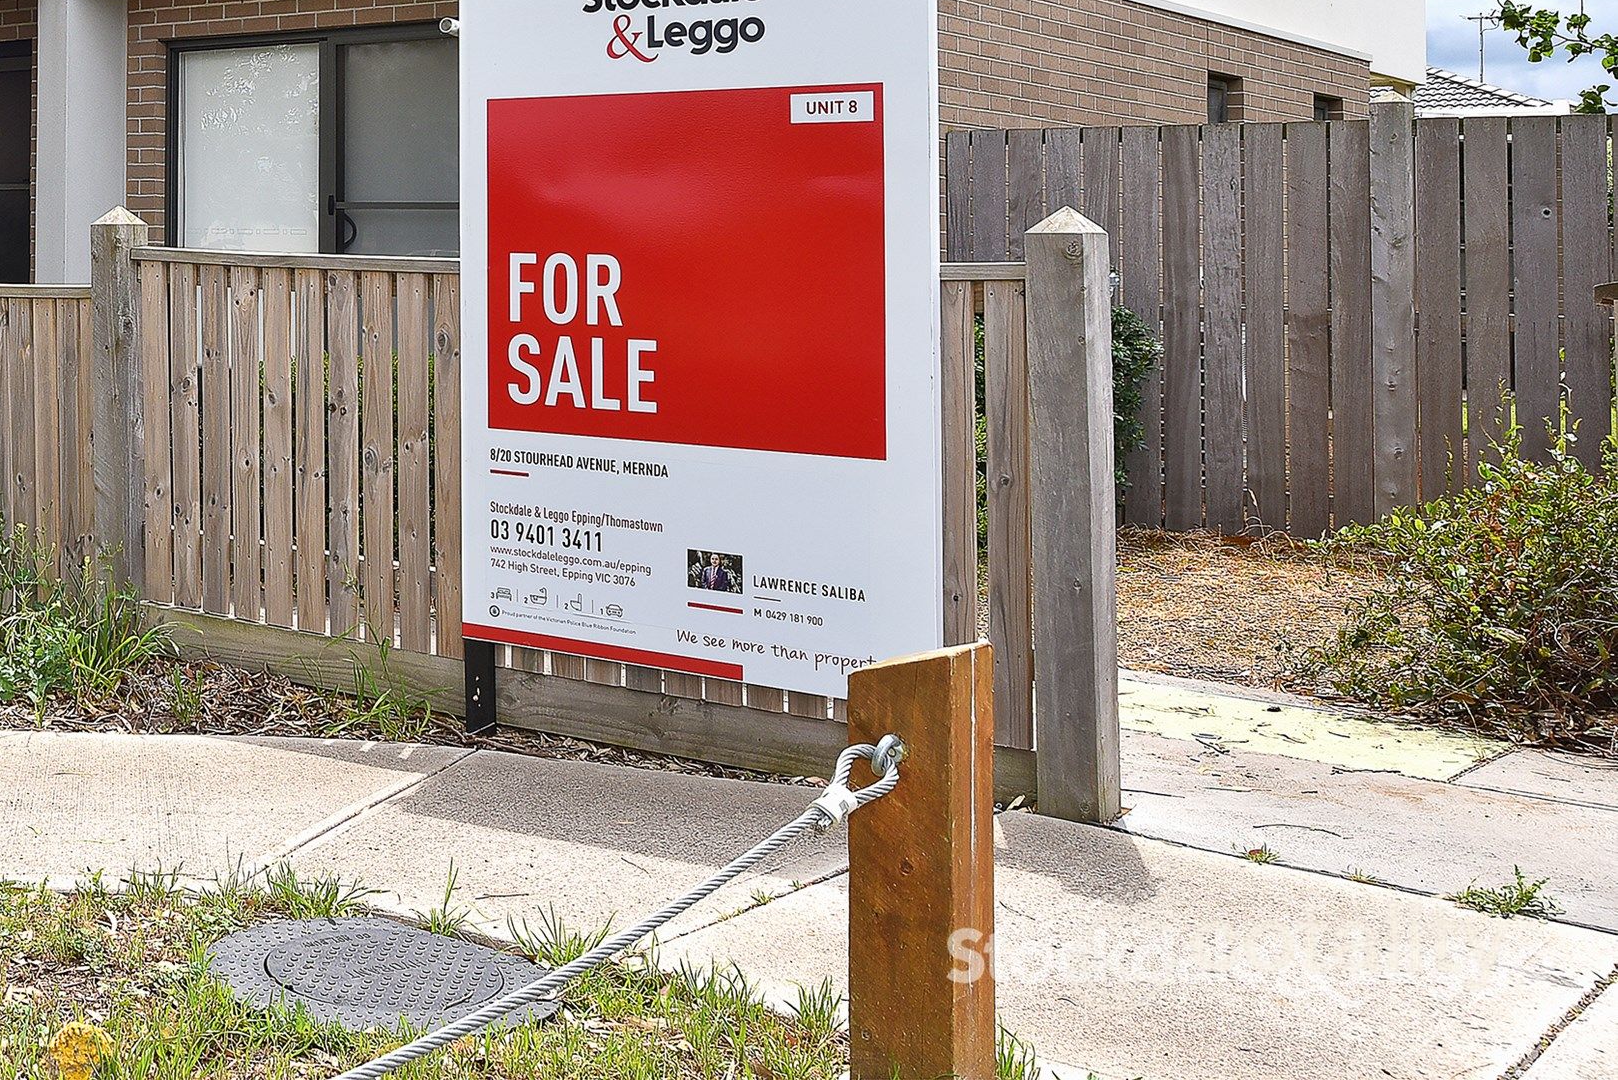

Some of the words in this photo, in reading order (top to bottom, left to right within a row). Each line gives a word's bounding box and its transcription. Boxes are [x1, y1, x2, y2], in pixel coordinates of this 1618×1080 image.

[606, 14, 659, 63] &
[647, 15, 766, 55] Leggo
[805, 100, 843, 116] UNIT
[848, 100, 859, 115] 8
[508, 252, 623, 327] FOR
[507, 333, 658, 414] SALE
[490, 447, 512, 463] 8/20
[514, 450, 574, 469] STOURHEAD
[576, 456, 620, 475] AVENUE,
[622, 460, 669, 478] MERNDA
[490, 500, 532, 517] Stockdale
[534, 506, 542, 519] &
[543, 507, 569, 524] Leggo
[572, 510, 664, 533] Epping/Thomastown
[490, 519, 510, 540] 03
[515, 522, 555, 546] 9401
[562, 527, 603, 552] 3411
[490, 545, 652, 576] www.stockdaleleggo.com.au/epping
[490, 558, 506, 569] 742
[507, 560, 528, 573] High
[530, 563, 560, 578] Street,
[562, 568, 593, 584] Epping
[595, 572, 611, 583] VIC
[613, 574, 636, 587] 3076
[490, 591, 495, 599] 3
[523, 596, 528, 604] 2
[753, 575, 817, 596] LAWRENCE
[822, 584, 866, 602] SALIBA
[502, 609, 516, 618] Proud
[564, 602, 569, 610] 2
[753, 608, 762, 618] M
[765, 610, 787, 621] 0429
[789, 613, 804, 624] 181
[807, 615, 823, 626] 900
[676, 629, 698, 644] We
[702, 634, 726, 649] see
[732, 639, 765, 655] more
[771, 644, 808, 661] than
[814, 652, 877, 675] propert
